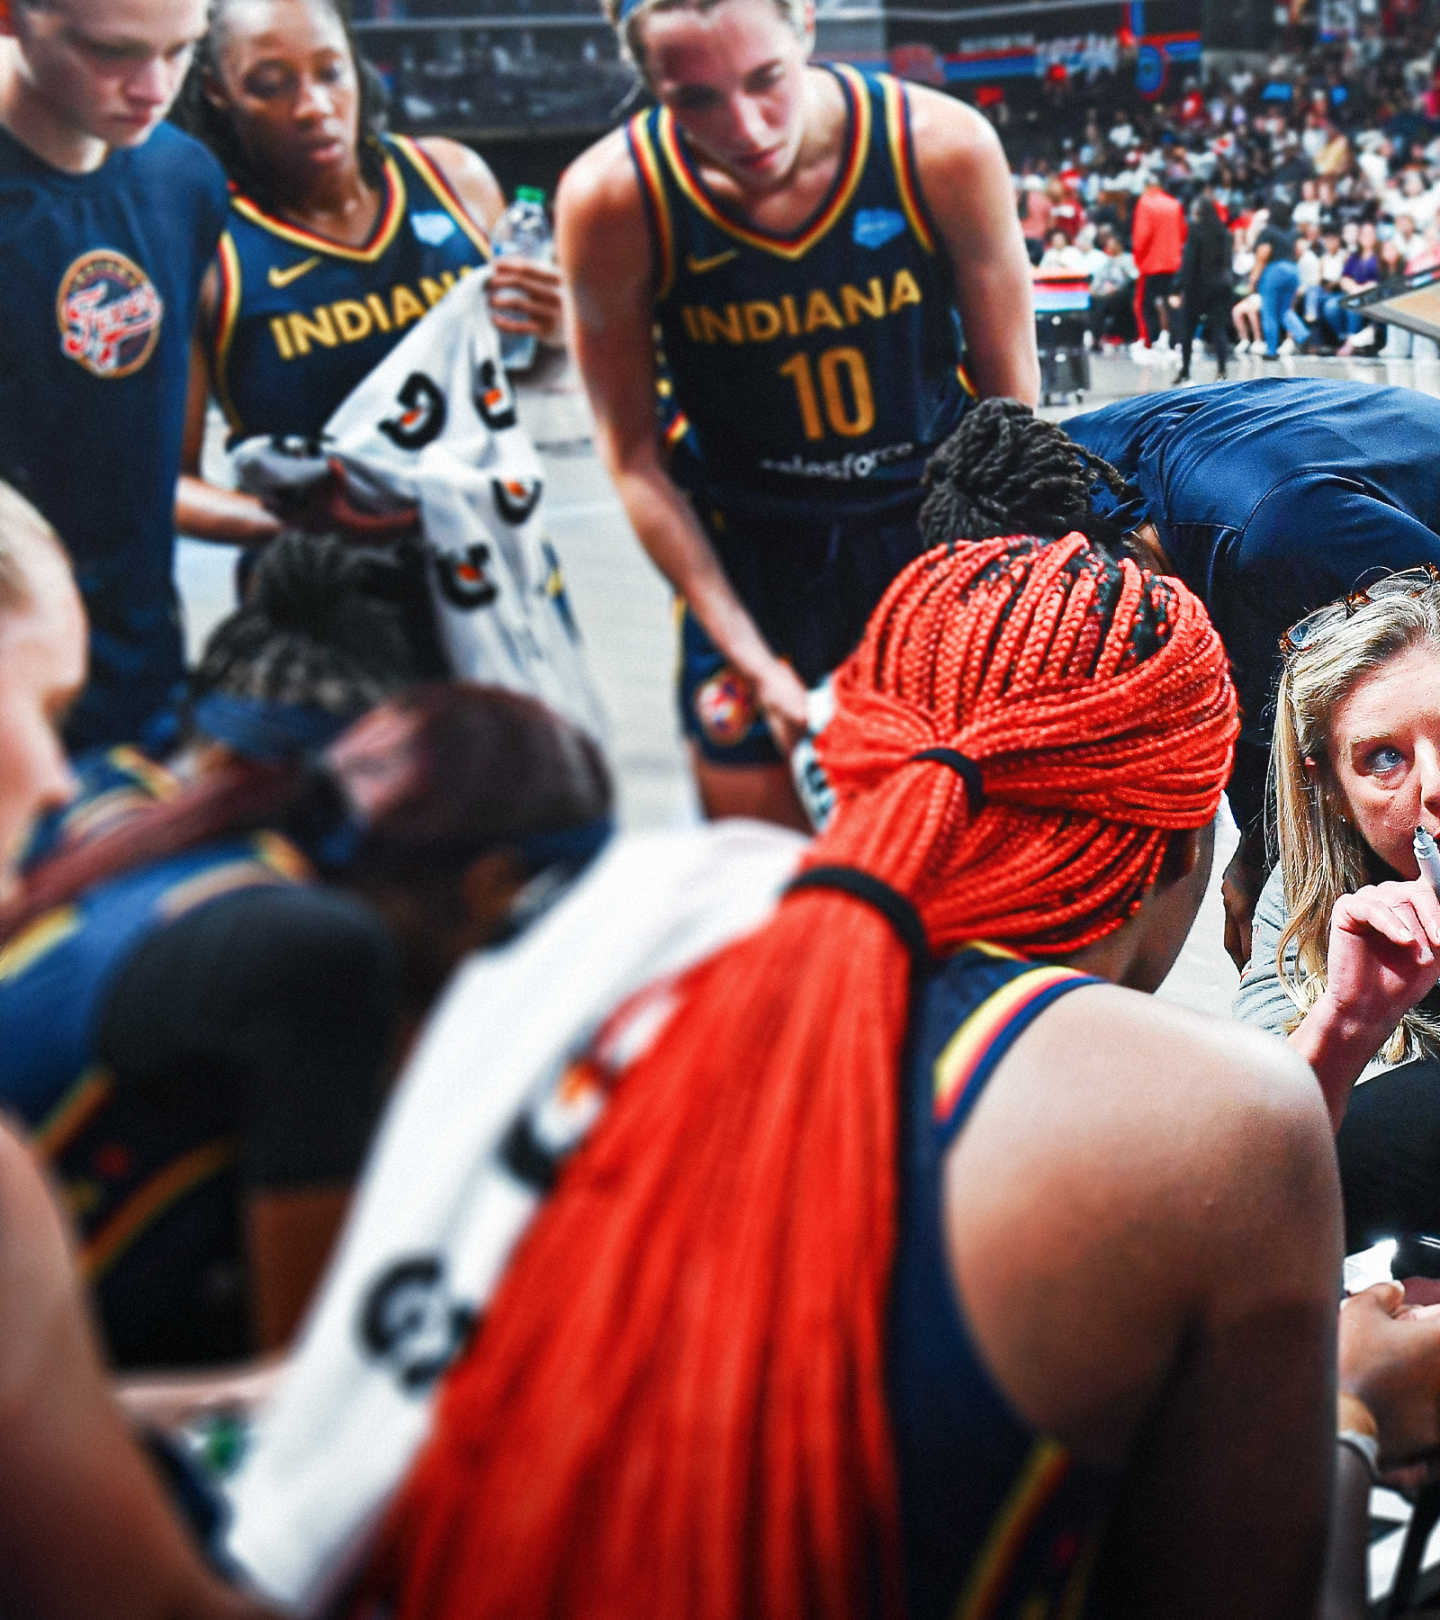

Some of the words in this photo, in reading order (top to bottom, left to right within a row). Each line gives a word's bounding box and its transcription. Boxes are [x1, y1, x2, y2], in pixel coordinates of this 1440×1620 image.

[271, 266, 472, 358] INDIAN
[683, 269, 921, 343] INDIANA
[778, 346, 876, 441] 10
